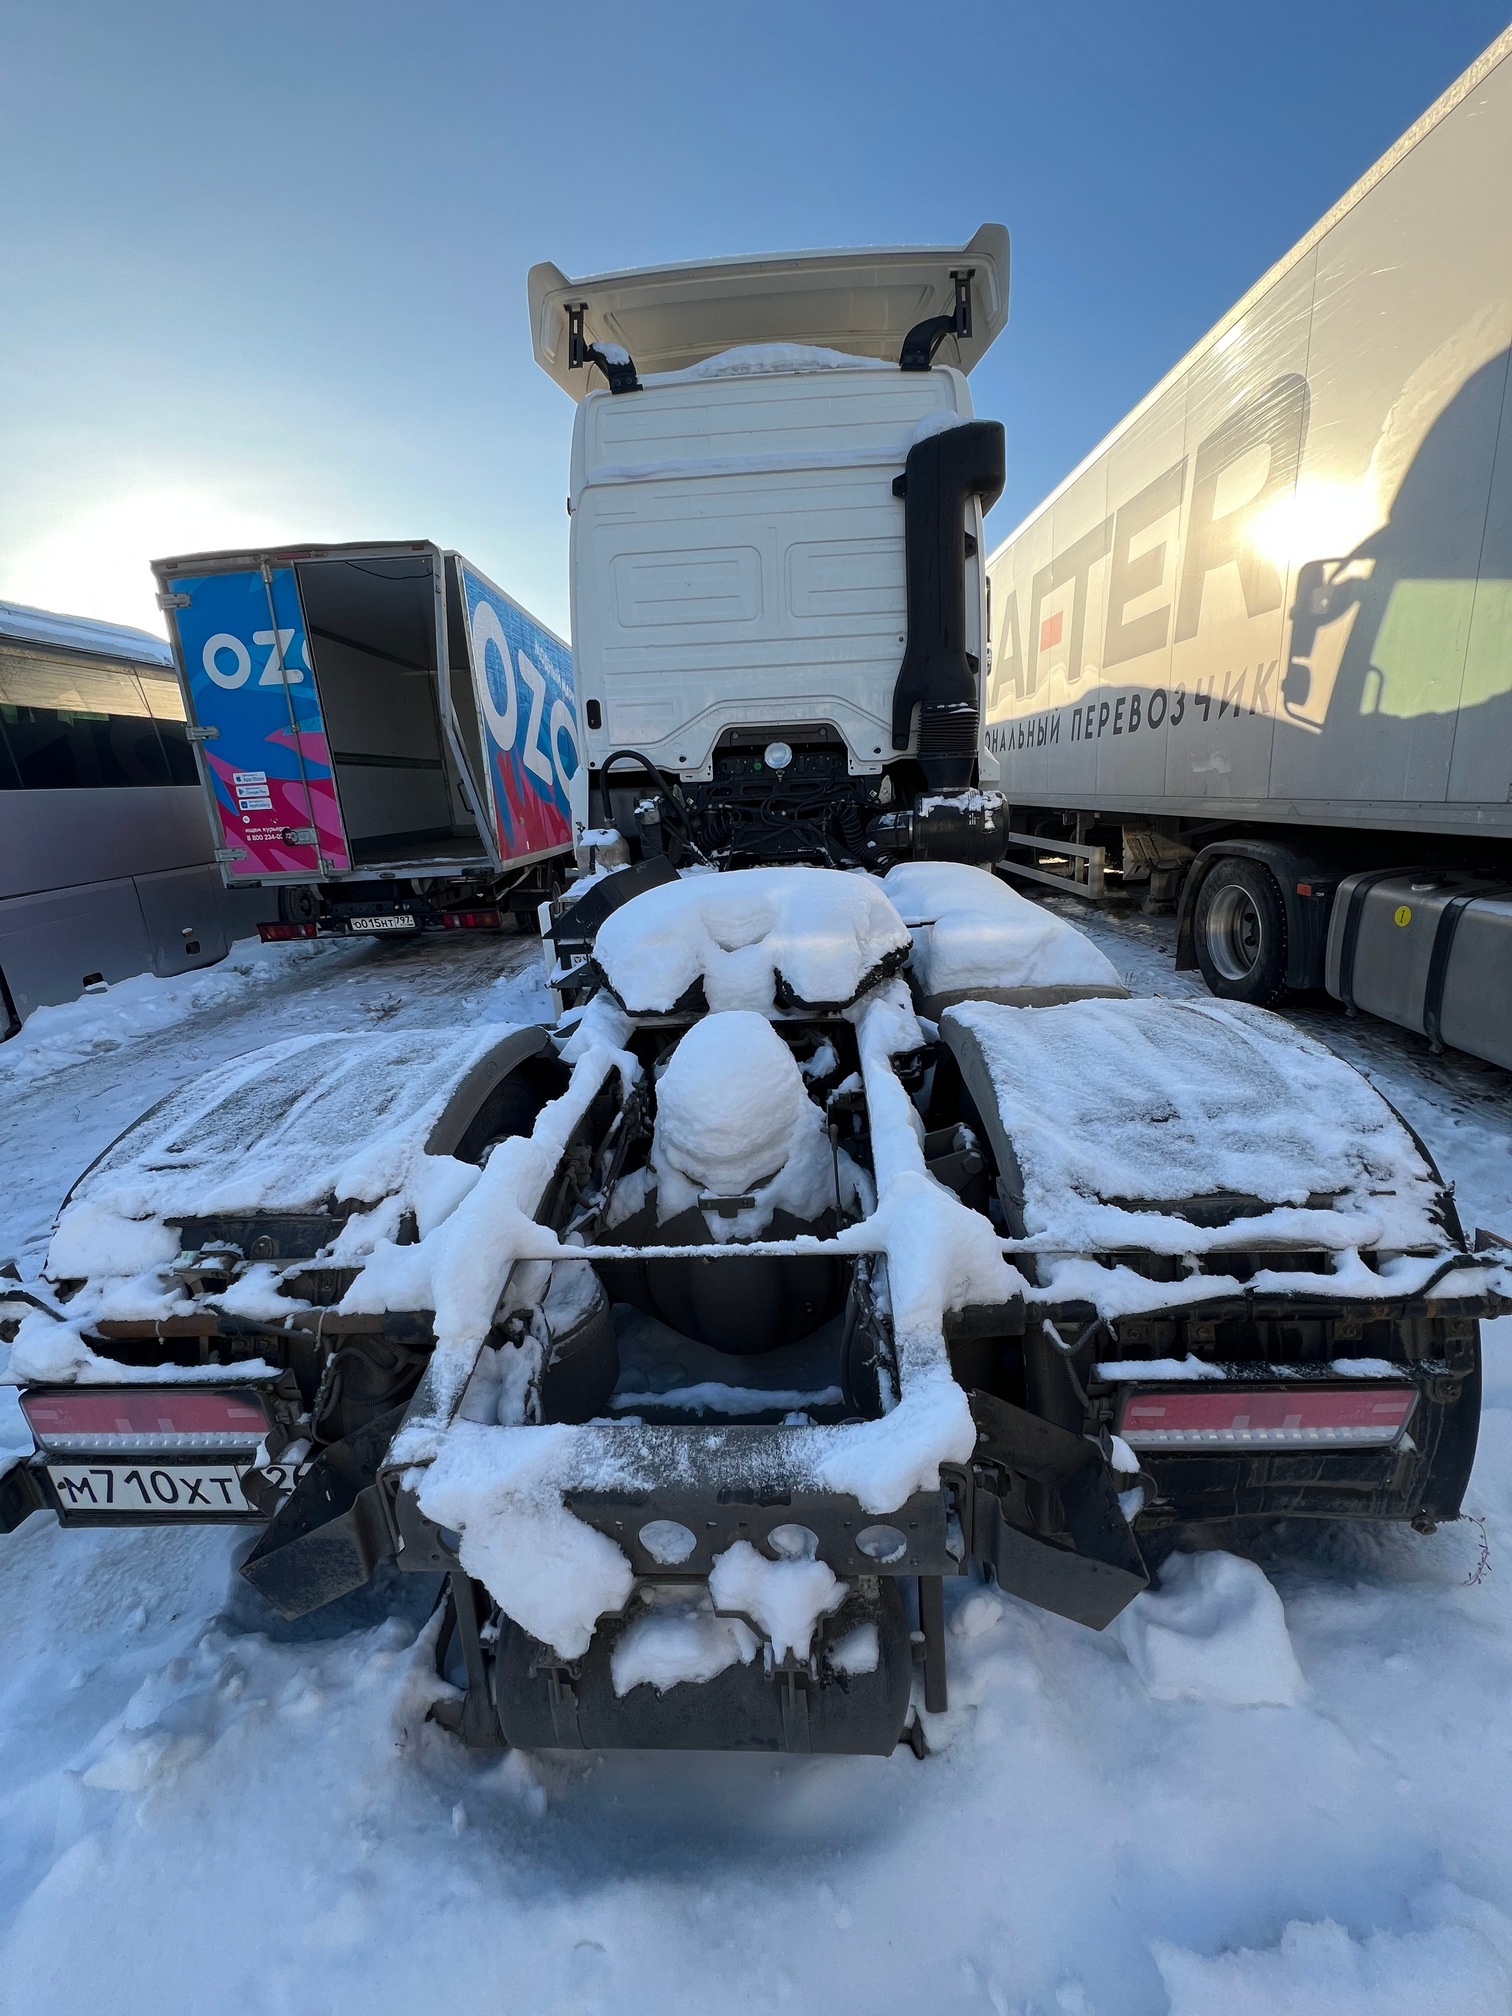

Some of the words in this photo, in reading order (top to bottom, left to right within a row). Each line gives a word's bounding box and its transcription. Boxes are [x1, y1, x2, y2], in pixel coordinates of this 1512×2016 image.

[986, 372, 1312, 709] AFTER
[203, 629, 312, 690] OZ
[1071, 659, 1280, 742] ПЕРЕВОЗЧИК
[395, 916, 409, 924] 797
[63, 1470, 233, 1505] М710ХТ
